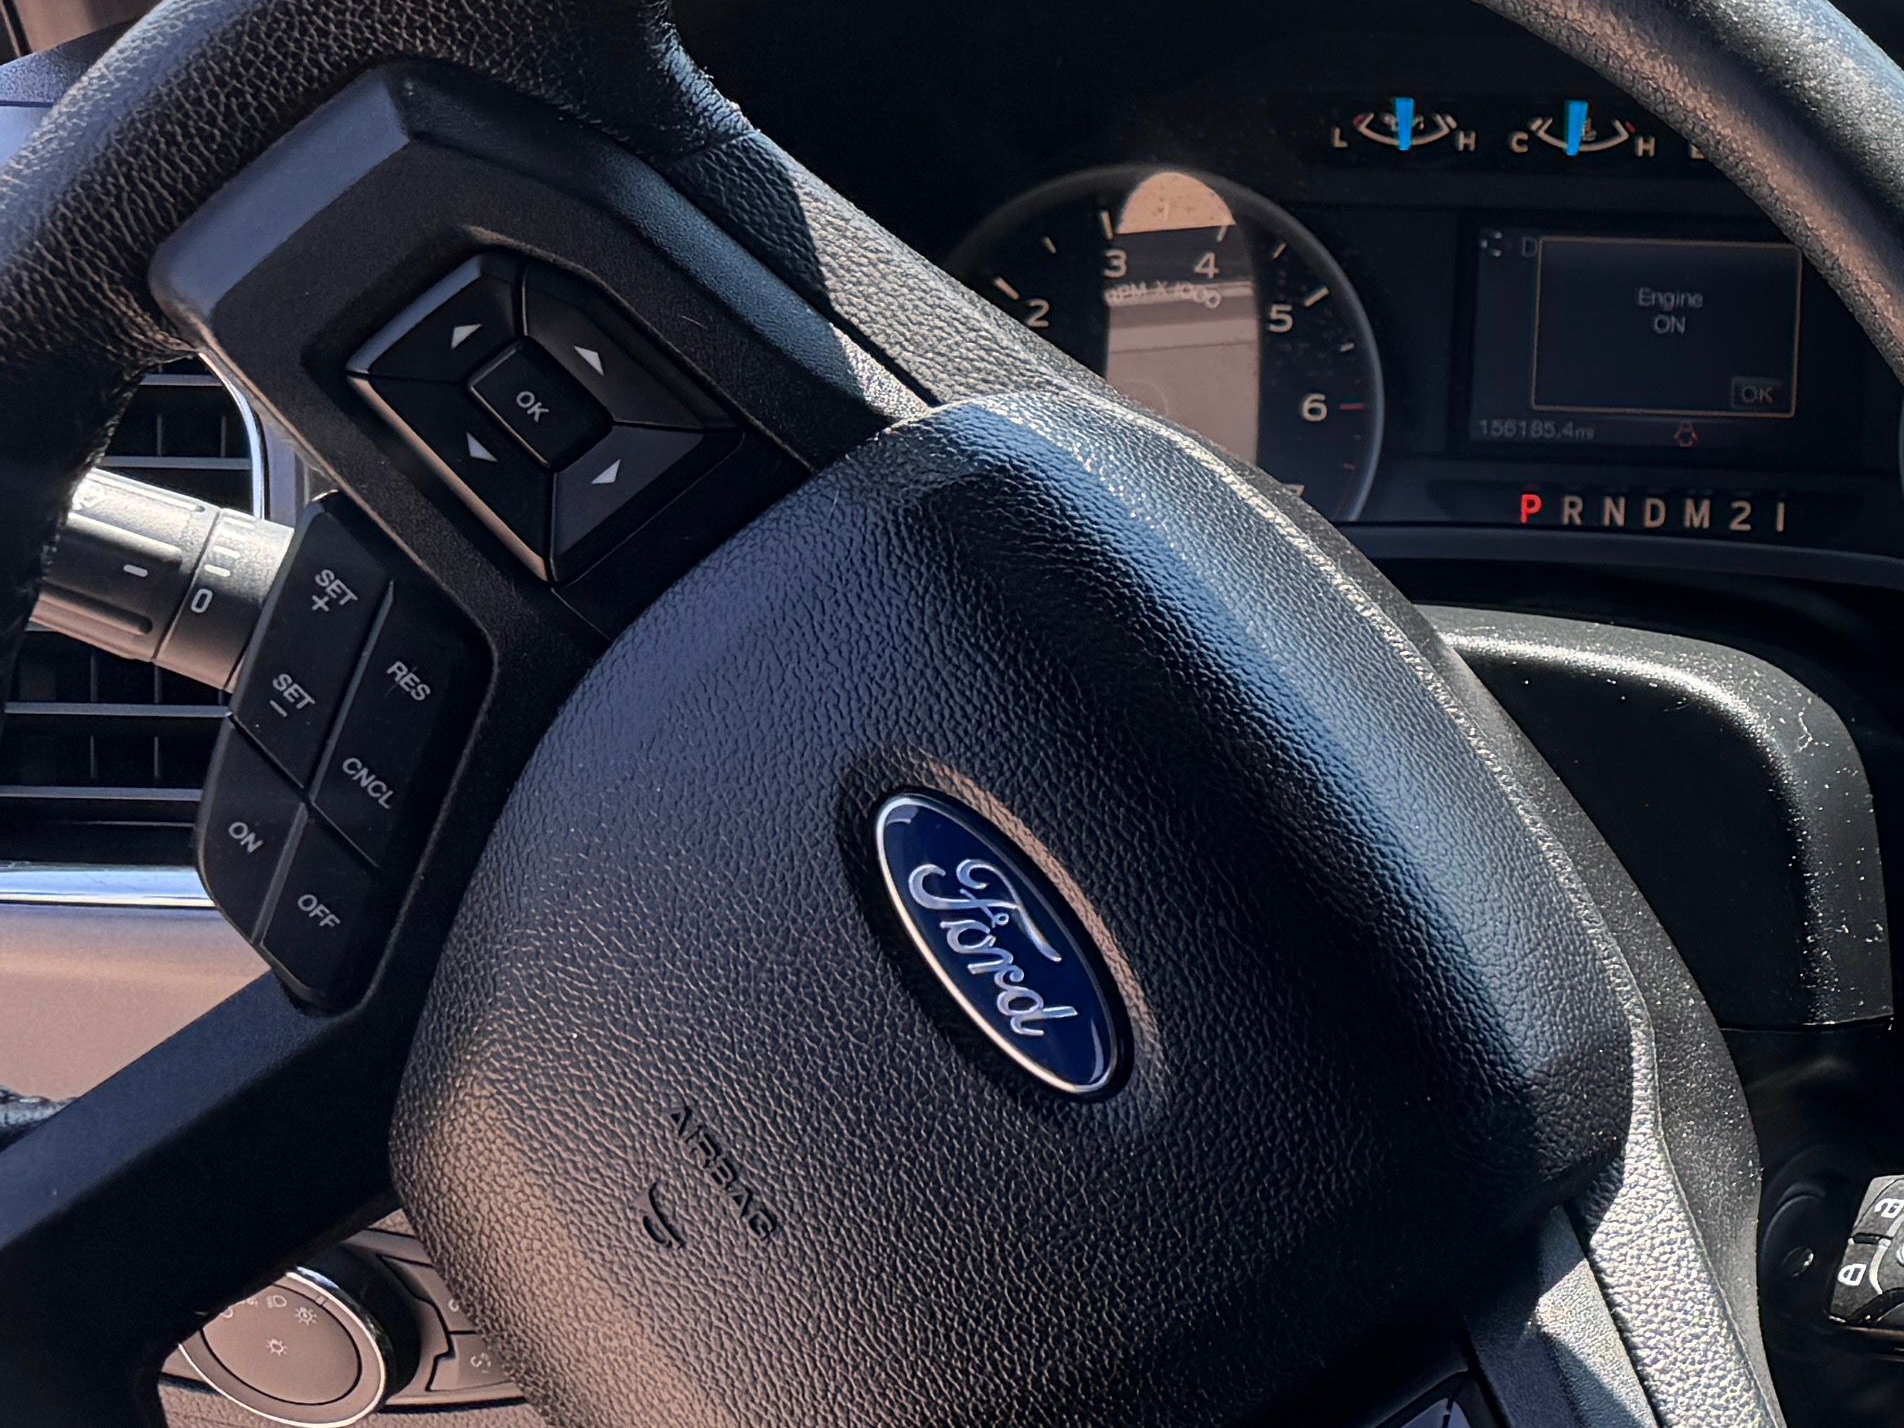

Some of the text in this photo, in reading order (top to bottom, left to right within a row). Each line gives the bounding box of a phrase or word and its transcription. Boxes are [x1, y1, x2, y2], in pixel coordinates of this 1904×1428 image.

[1456, 130, 1476, 152] H
[1510, 131, 1529, 153] C
[1634, 135, 1656, 157] H
[1103, 249, 1128, 278] 3
[1193, 251, 1220, 280] 4
[1025, 298, 1050, 328] 2
[1637, 287, 1703, 309] Engine
[1267, 303, 1294, 334] 5
[1653, 315, 1686, 334] ON
[515, 389, 550, 421] OK
[1301, 394, 1329, 422] 6
[1740, 385, 1775, 404] OK
[1519, 493, 1543, 524] P
[1562, 495, 1585, 525] R
[1603, 496, 1626, 526] N
[1643, 497, 1666, 527] D
[1683, 498, 1711, 529] M
[1729, 500, 1752, 531] 2
[314, 568, 359, 606] SET
[272, 672, 317, 710] SET
[386, 660, 432, 702] RES
[341, 757, 396, 810] CNCL
[227, 820, 264, 854] ON
[297, 892, 341, 930] OFF
[907, 856, 1079, 1039] Ford
[661, 1105, 778, 1241] AIRBAG
